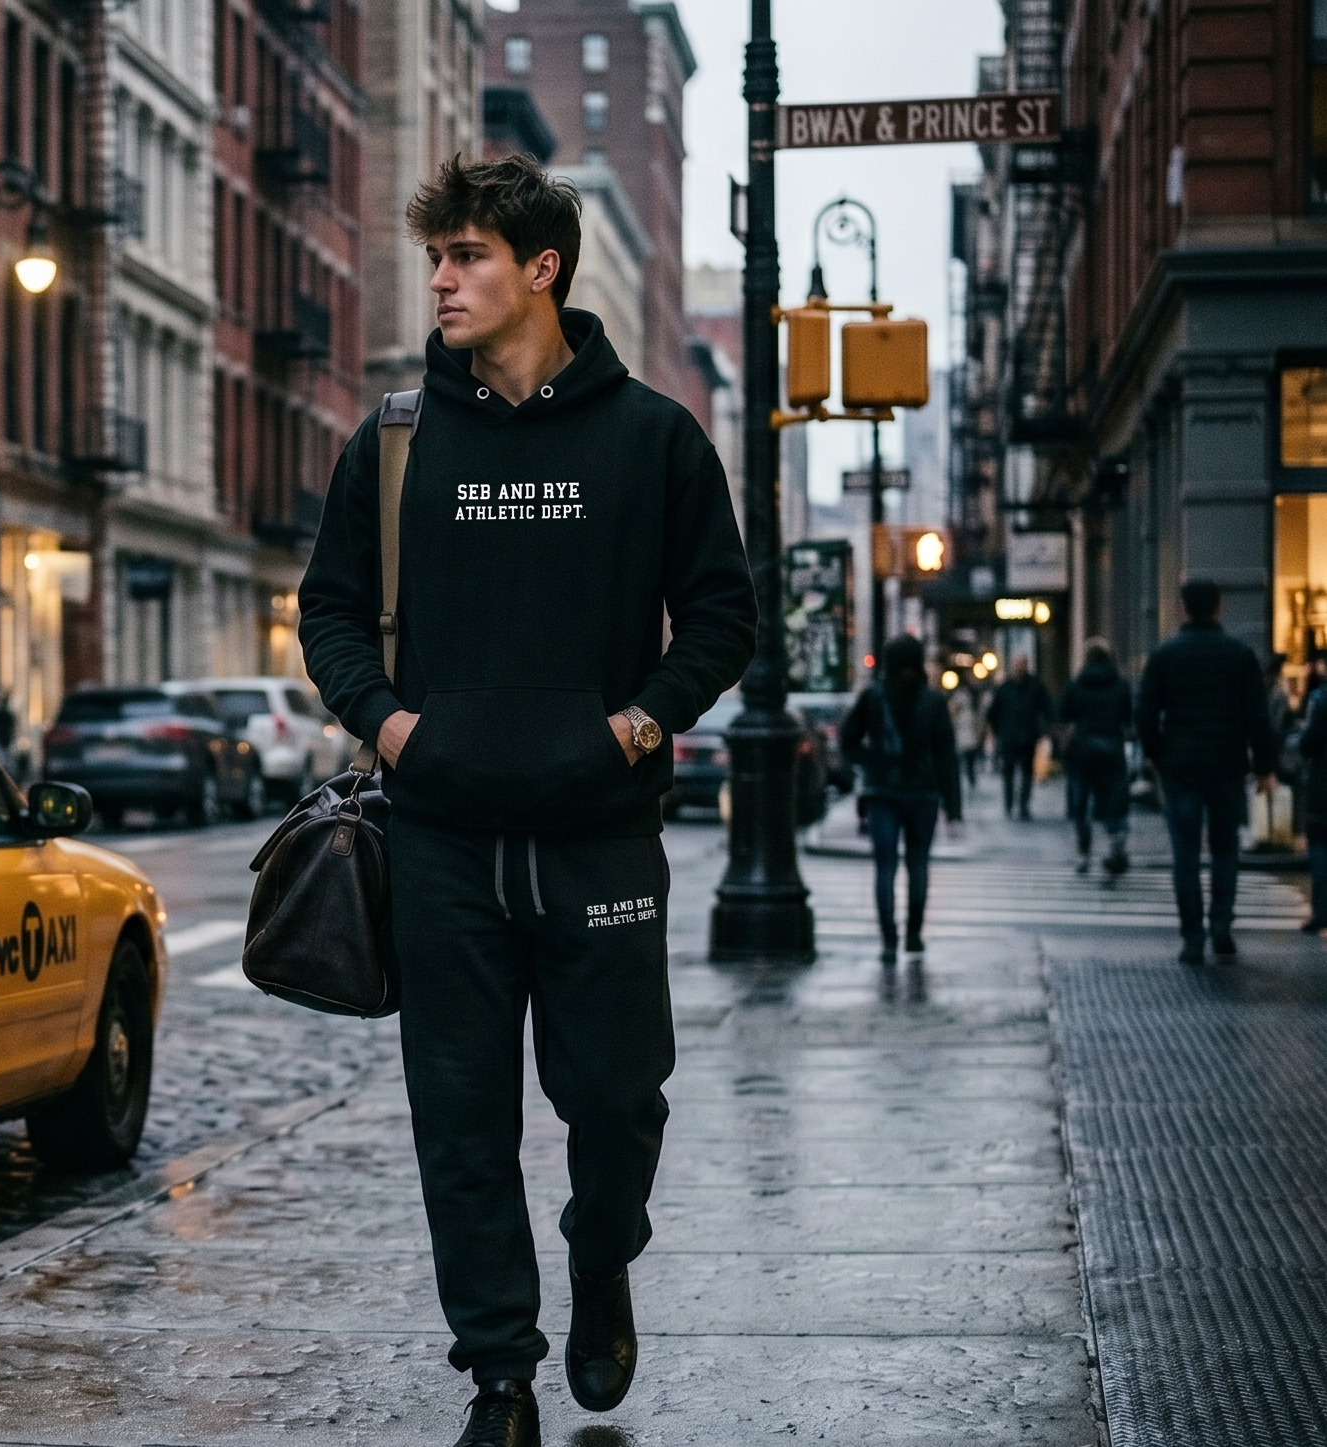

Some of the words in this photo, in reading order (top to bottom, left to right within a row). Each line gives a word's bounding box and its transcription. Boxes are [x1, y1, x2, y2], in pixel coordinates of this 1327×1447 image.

[792, 107, 865, 144] BWAY
[876, 105, 896, 140] &
[907, 101, 1006, 140] PRINCE
[1016, 98, 1050, 135] ST
[457, 484, 491, 500] SEB
[498, 483, 535, 500] AND
[543, 482, 580, 499] RYE
[455, 505, 535, 520] ATHLETIC
[541, 504, 587, 519] DEPT.
[586, 904, 608, 916] SEB
[612, 900, 634, 913] AND
[587, 913, 636, 928] ATHLETIC
